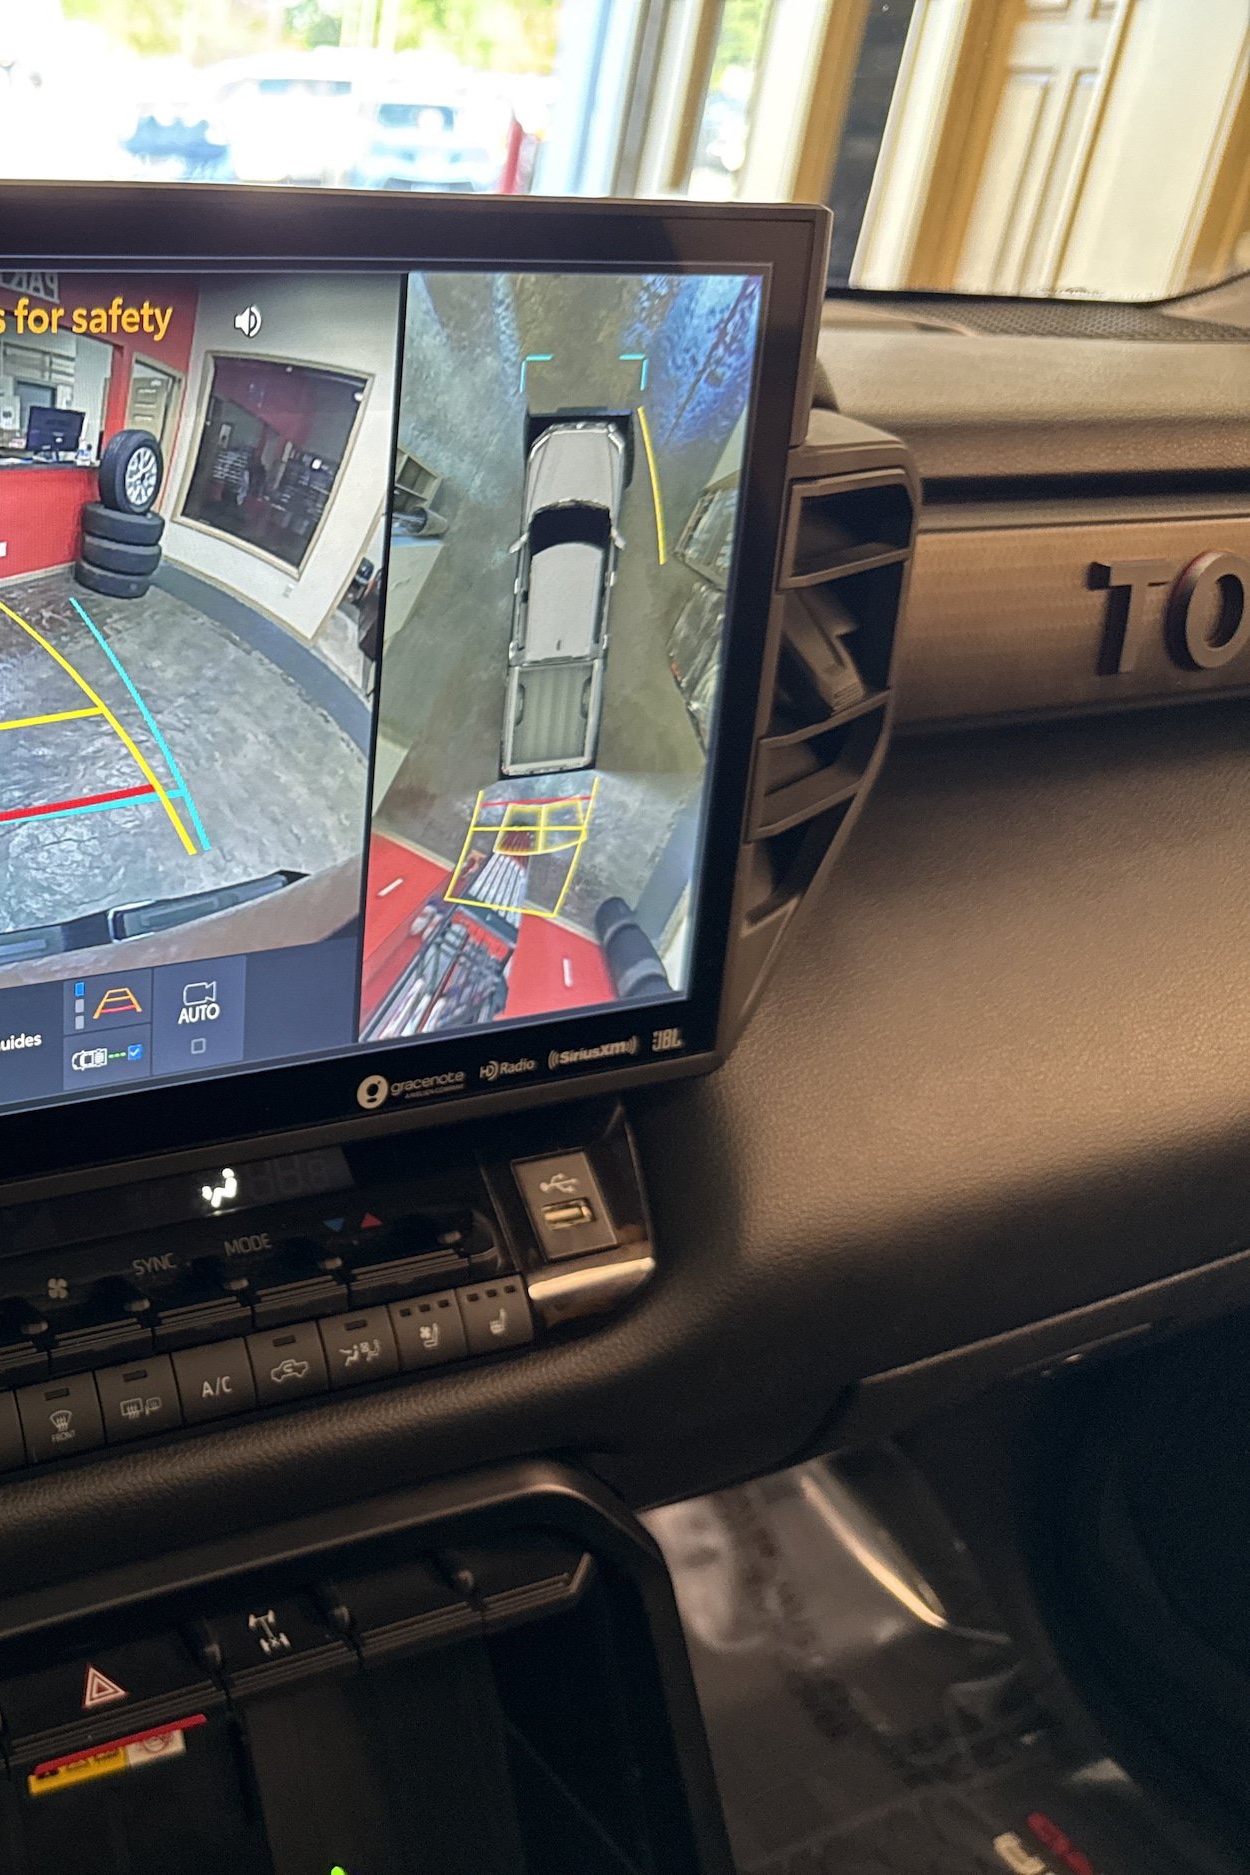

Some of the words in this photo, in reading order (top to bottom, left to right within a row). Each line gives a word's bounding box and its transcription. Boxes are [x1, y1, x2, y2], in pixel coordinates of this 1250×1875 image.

[14, 297, 64, 335] for
[72, 298, 173, 340] safety
[178, 1003, 221, 1024] AUTO
[653, 1028, 682, 1051] JBL
[500, 1058, 535, 1075] Radio
[391, 1071, 465, 1096] gracenote
[224, 1232, 271, 1257] MODE
[133, 1252, 177, 1278] SYNC
[201, 1375, 233, 1398] A/C
[51, 1429, 76, 1443] FRONT
